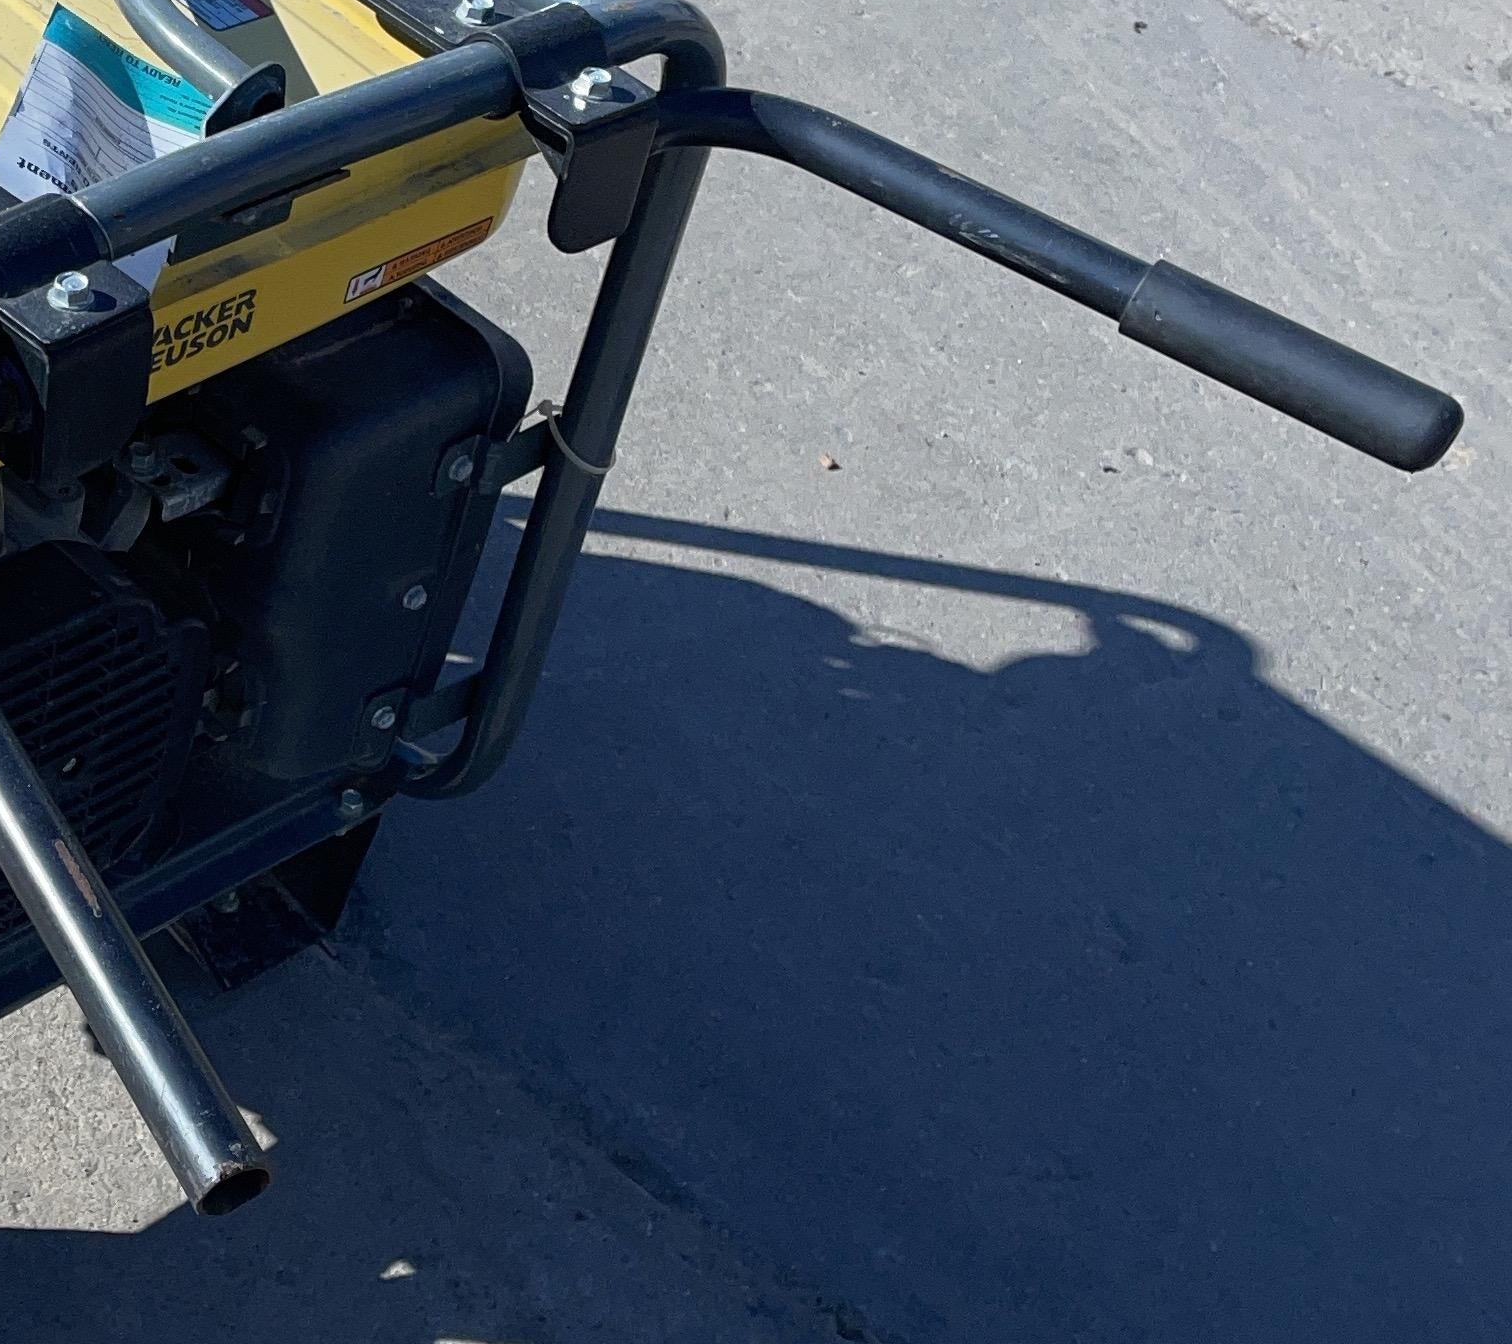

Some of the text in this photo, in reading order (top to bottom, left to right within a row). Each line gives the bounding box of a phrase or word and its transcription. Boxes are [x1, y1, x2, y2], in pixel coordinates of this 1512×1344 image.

[141, 64, 182, 88] READY
[150, 311, 255, 374] EUSON
[152, 288, 257, 348] ACKER
